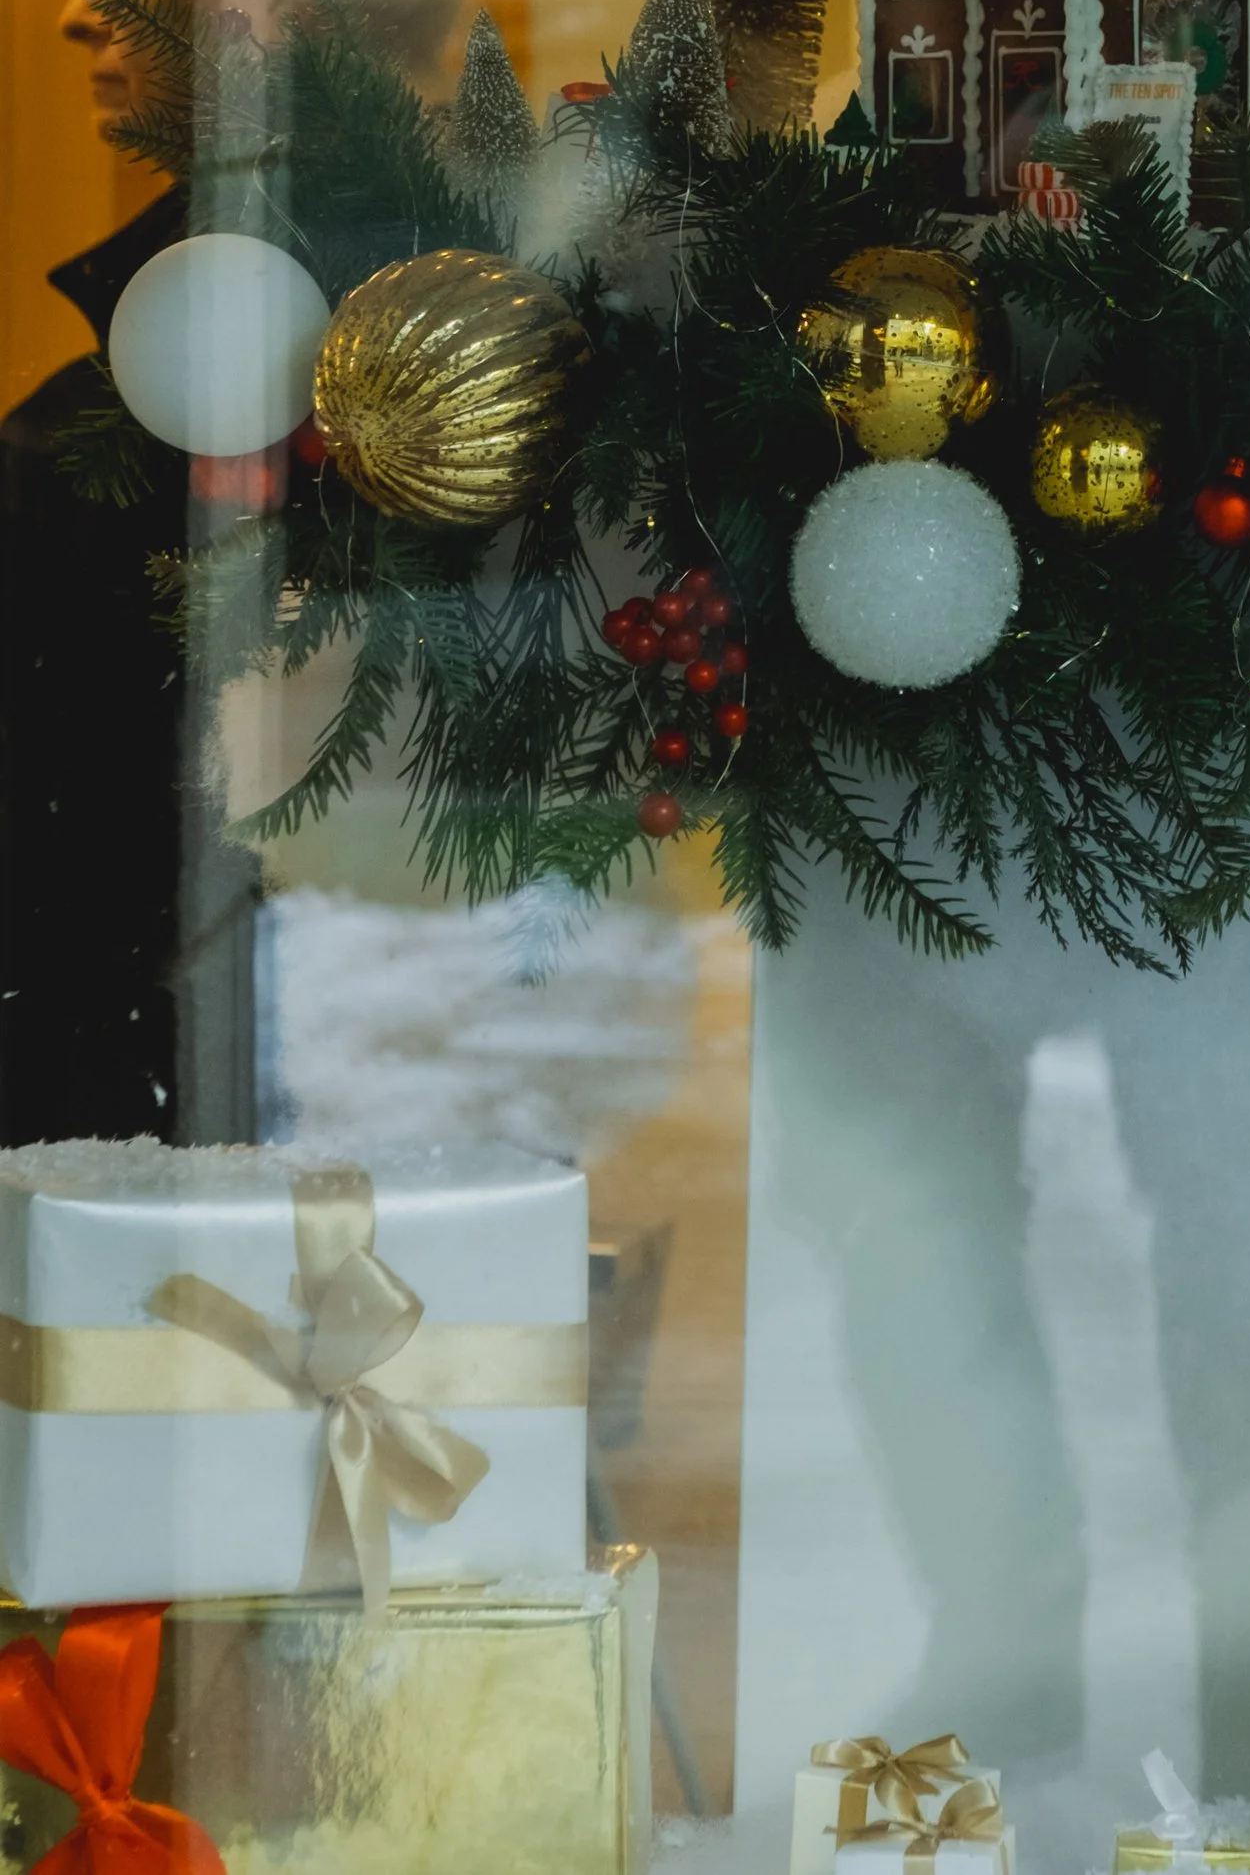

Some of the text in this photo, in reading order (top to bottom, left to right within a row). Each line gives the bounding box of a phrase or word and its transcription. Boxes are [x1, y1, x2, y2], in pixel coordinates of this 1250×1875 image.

[1109, 82, 1183, 100] THE TEN SPOT
